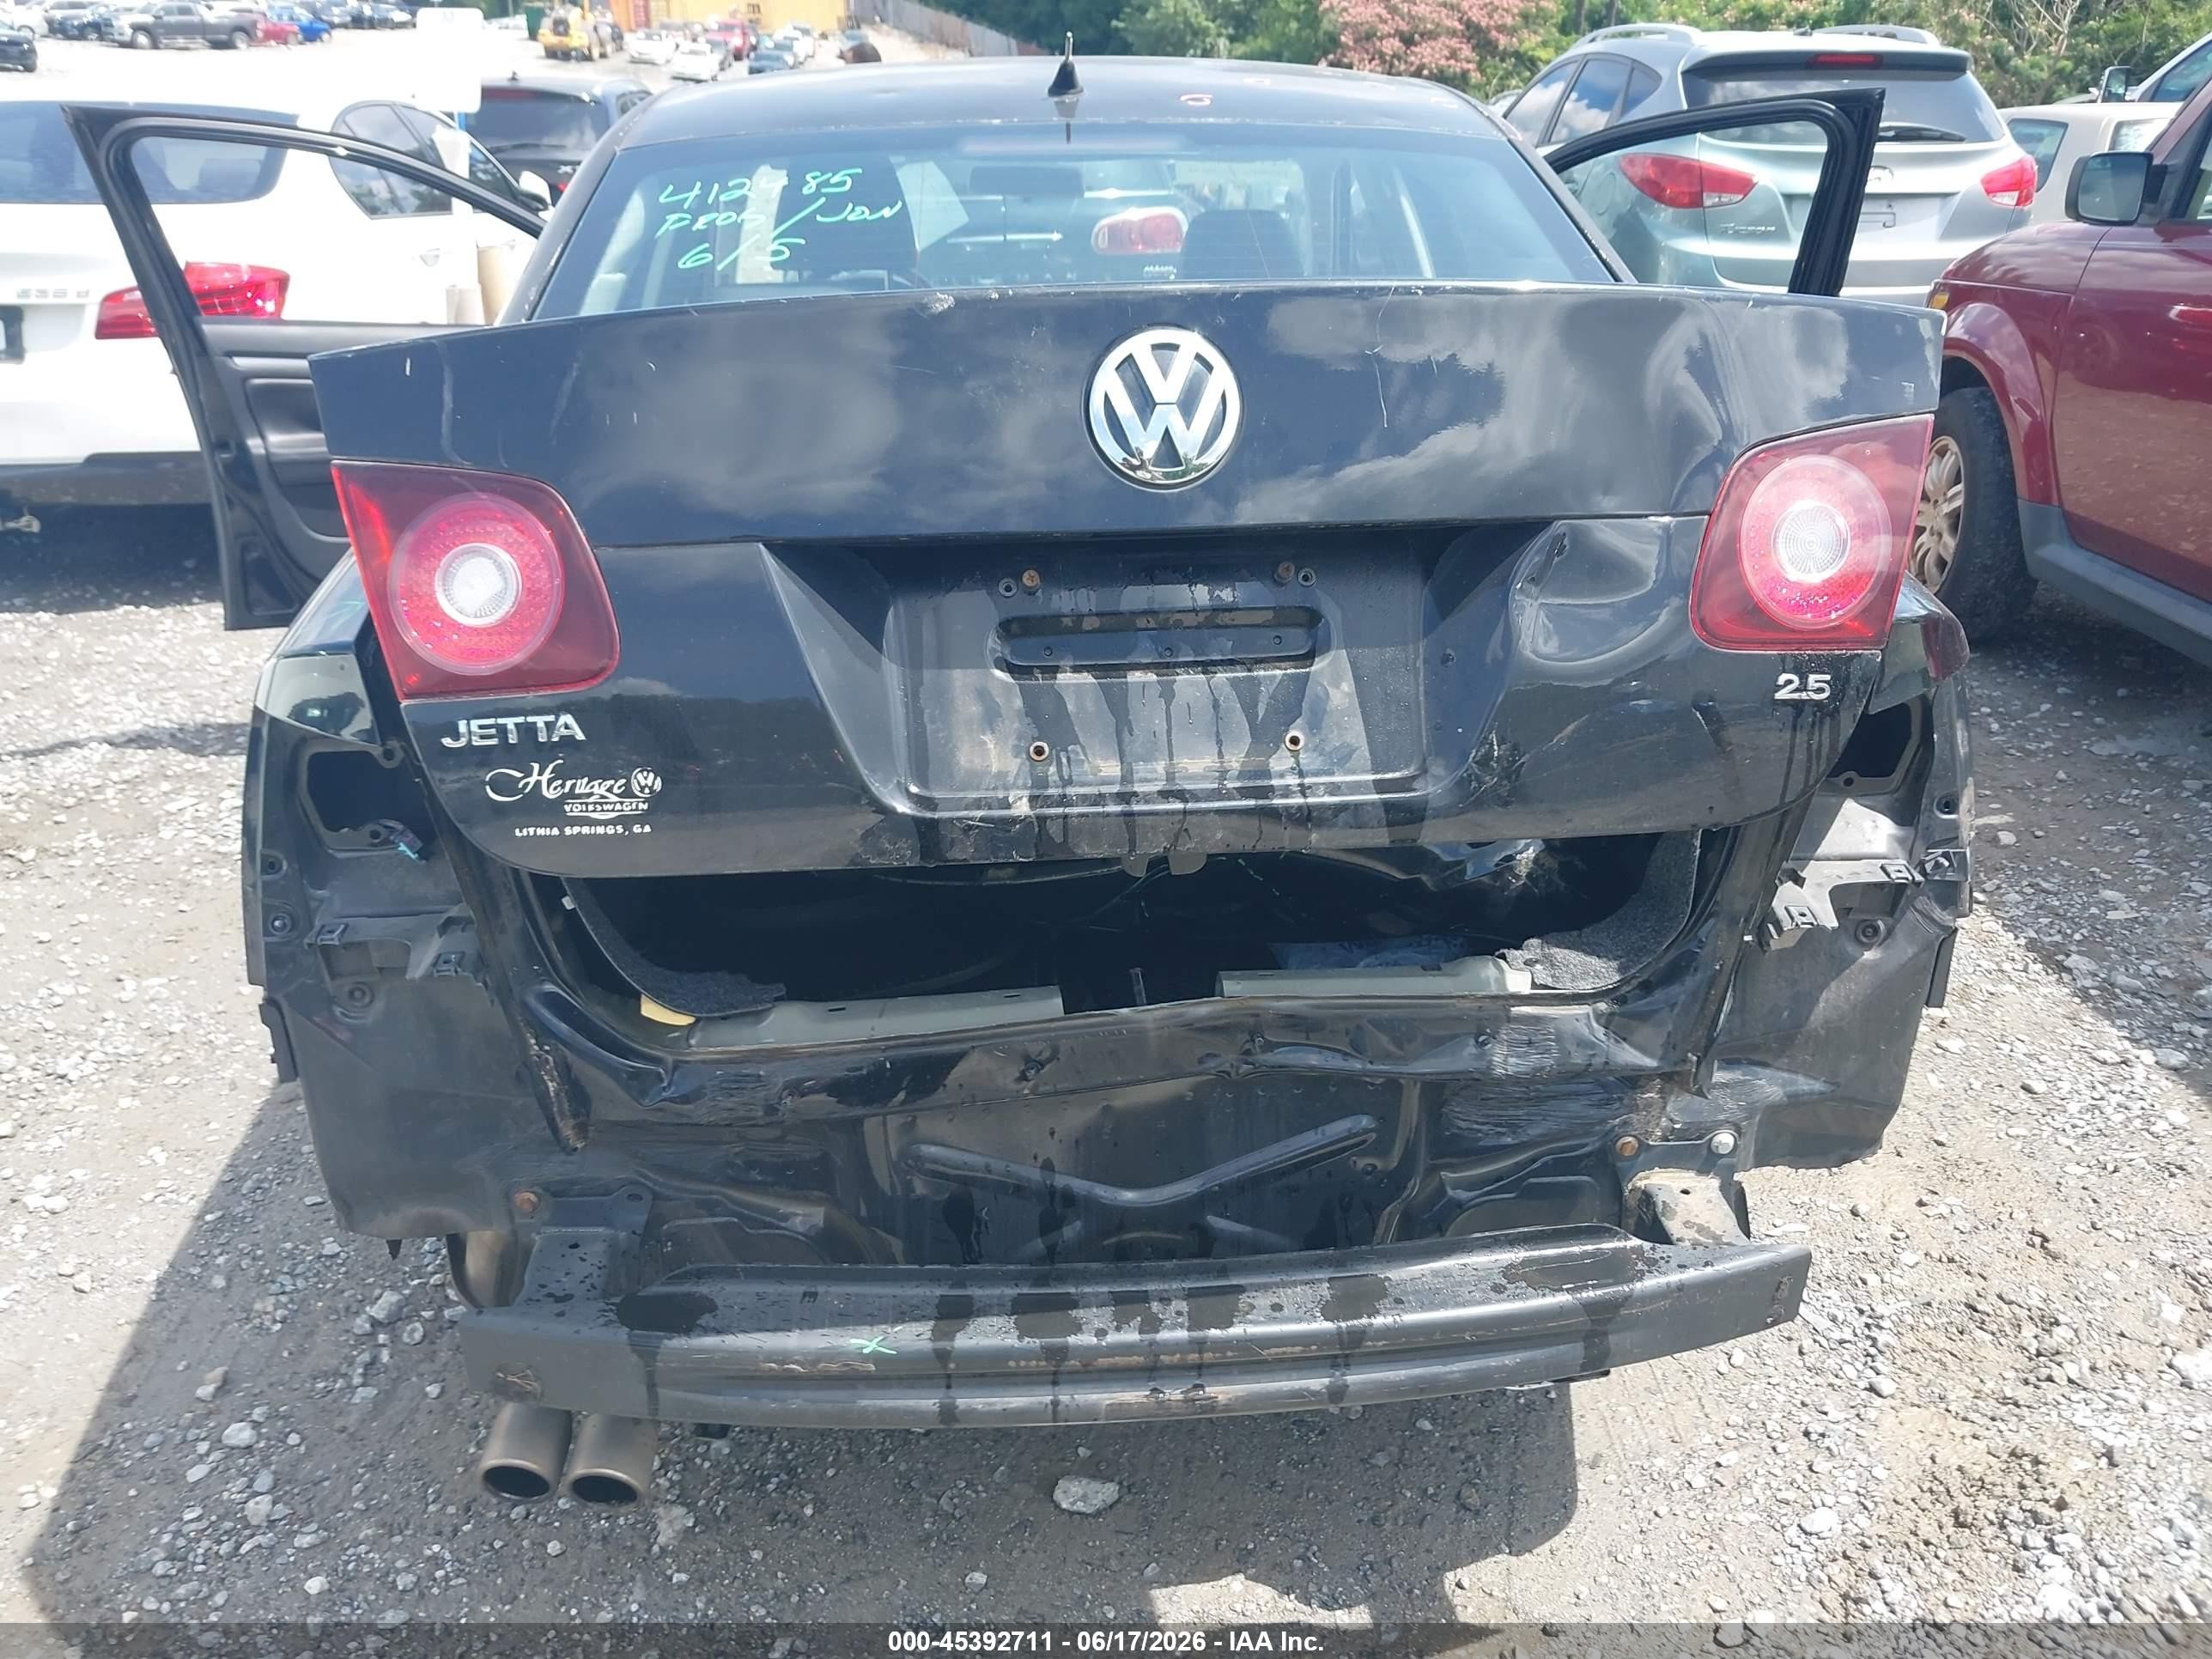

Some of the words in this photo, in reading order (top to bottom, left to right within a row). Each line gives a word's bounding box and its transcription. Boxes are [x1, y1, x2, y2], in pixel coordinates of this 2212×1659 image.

[677, 234, 806, 270] 6/5
[441, 713, 586, 748] JETTA
[515, 827, 560, 837] LITHIA
[563, 824, 629, 836] SPRINGS,
[633, 823, 652, 834] GA
